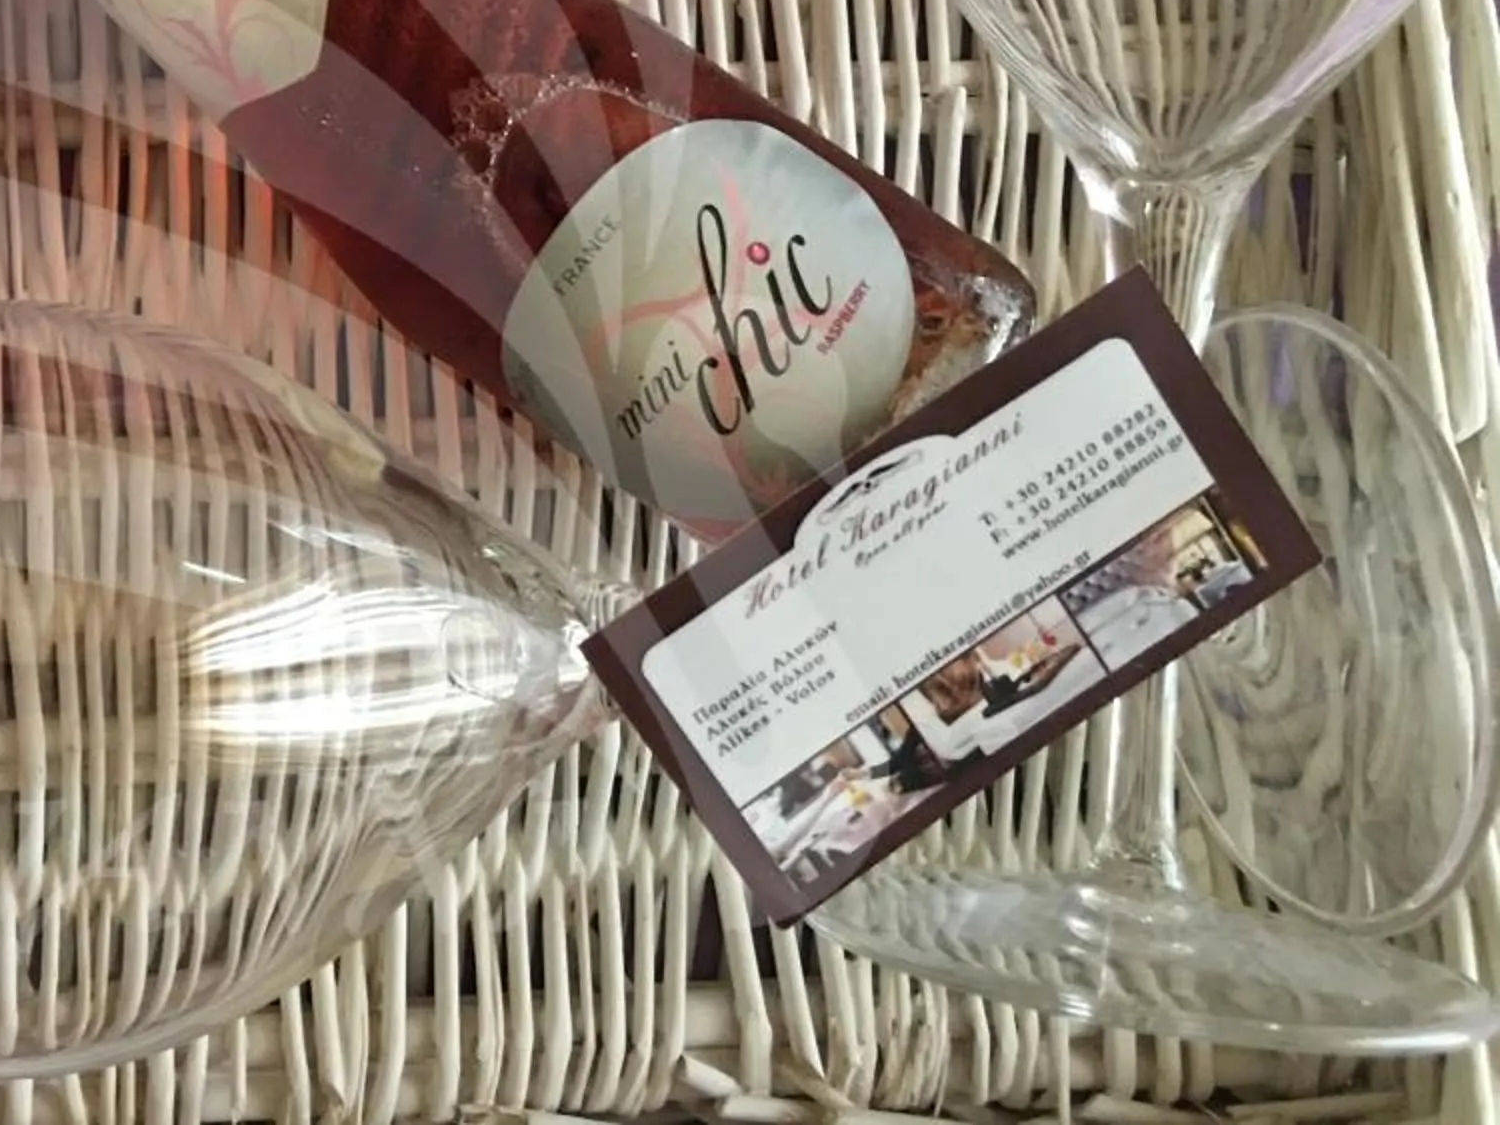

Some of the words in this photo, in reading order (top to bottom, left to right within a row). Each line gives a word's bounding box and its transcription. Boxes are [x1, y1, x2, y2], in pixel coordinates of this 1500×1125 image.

[553, 214, 619, 296] FRANCE
[617, 341, 692, 440] mini
[695, 204, 831, 437] chic
[817, 279, 871, 355] RASPBERRY
[989, 527, 1009, 545] F:
[1057, 456, 1110, 501] 24210
[1000, 433, 1184, 560] www.hotelkaragianni.gr
[1045, 441, 1098, 486] 24210
[743, 532, 830, 619] Hotel
[841, 412, 1022, 552] Karagianni
[844, 684, 890, 722] email:
[893, 550, 1092, 688] hotelkaragianni@yahoo.gr
[717, 714, 771, 757] Alikes
[784, 669, 835, 705] Volos
